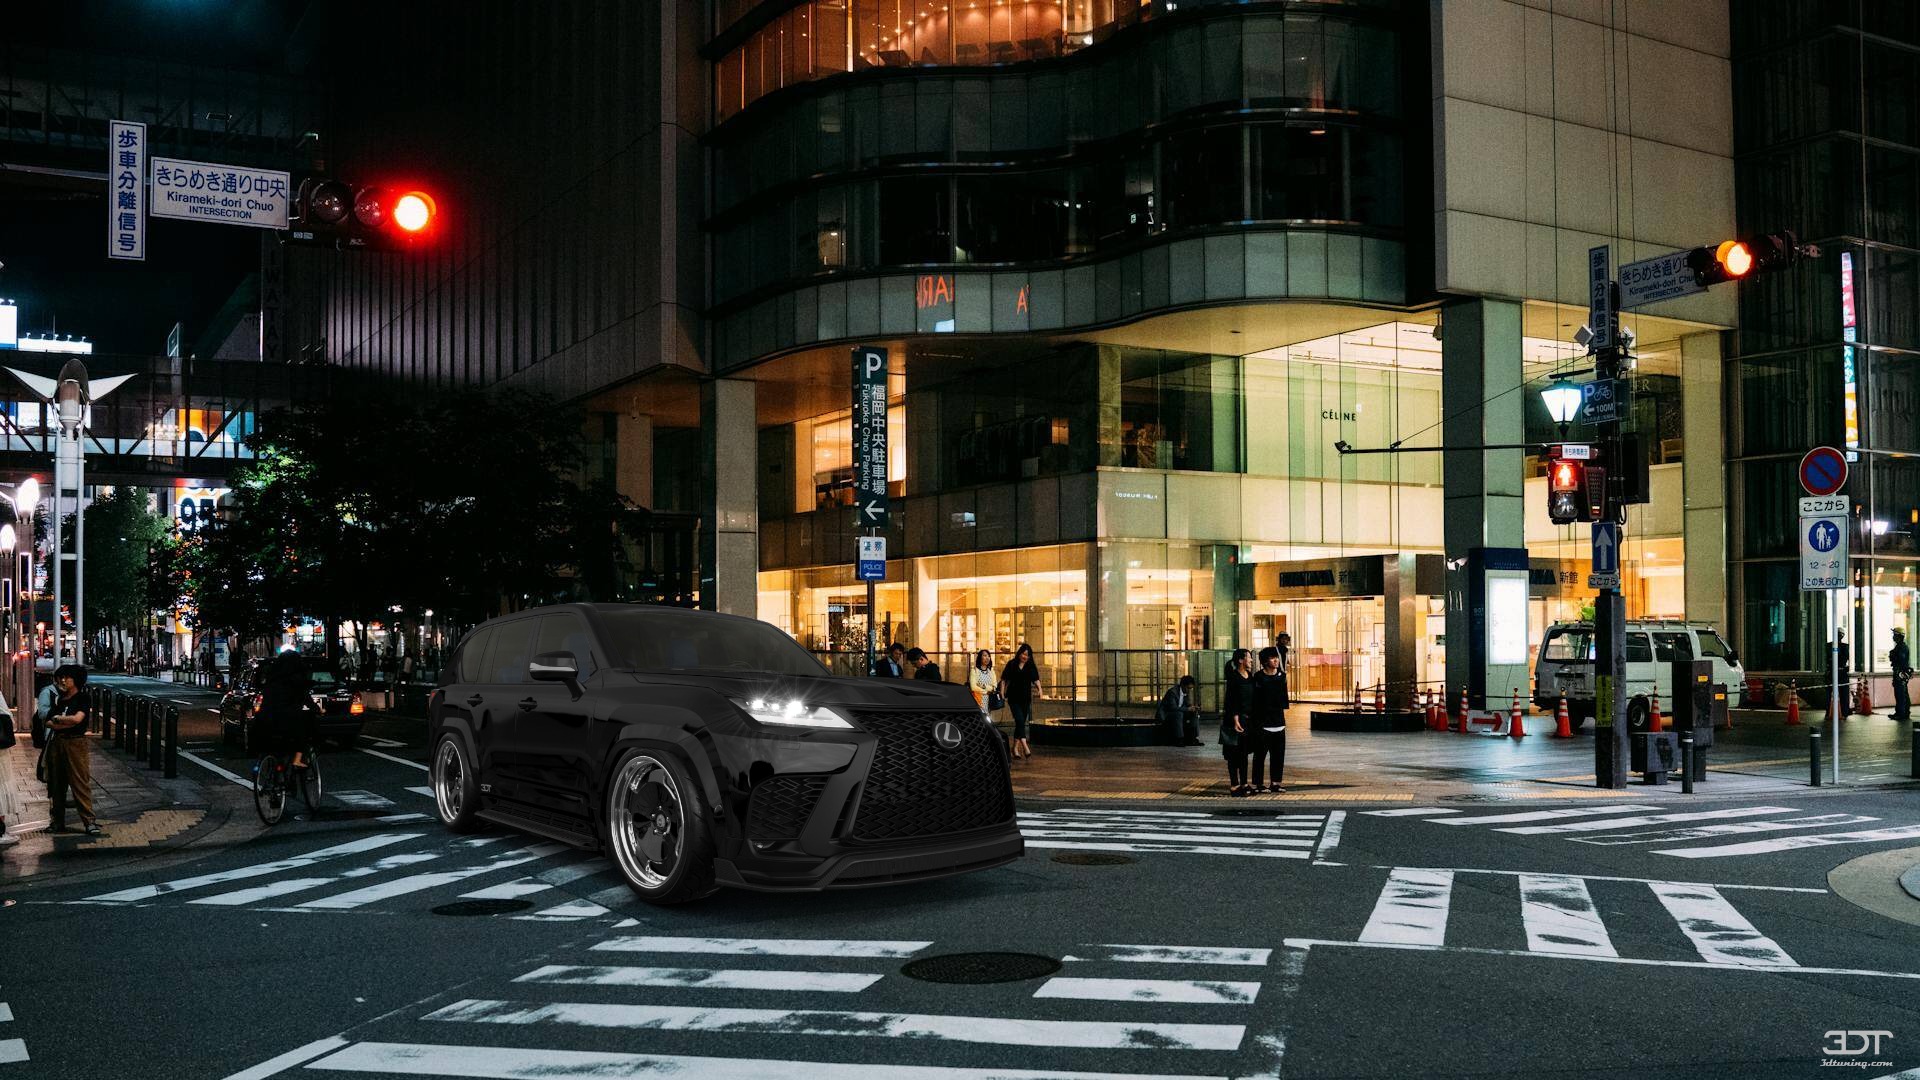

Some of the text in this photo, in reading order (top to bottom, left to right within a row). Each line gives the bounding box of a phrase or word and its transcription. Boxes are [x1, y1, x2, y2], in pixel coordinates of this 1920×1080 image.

[117, 130, 138, 251] 歩車分離信号
[156, 165, 286, 199] きらめき通り中央
[167, 191, 274, 212] Kirameki-dori Chuo
[189, 205, 252, 219] INTERSECTION
[1679, 274, 1697, 284] Chu
[1593, 252, 1606, 344] 歩車分離信号
[865, 353, 882, 379] P
[1584, 384, 1596, 403] P
[1322, 409, 1357, 421] CÉLINE
[861, 383, 871, 490] Fukuoka Chuo Parking
[871, 384, 886, 496] 福岡中央駐車場
[1803, 500, 1845, 512] ここから
[863, 563, 883, 571] POLICE
[1589, 576, 1618, 586] ここから
[1805, 577, 1844, 587] この先60m
